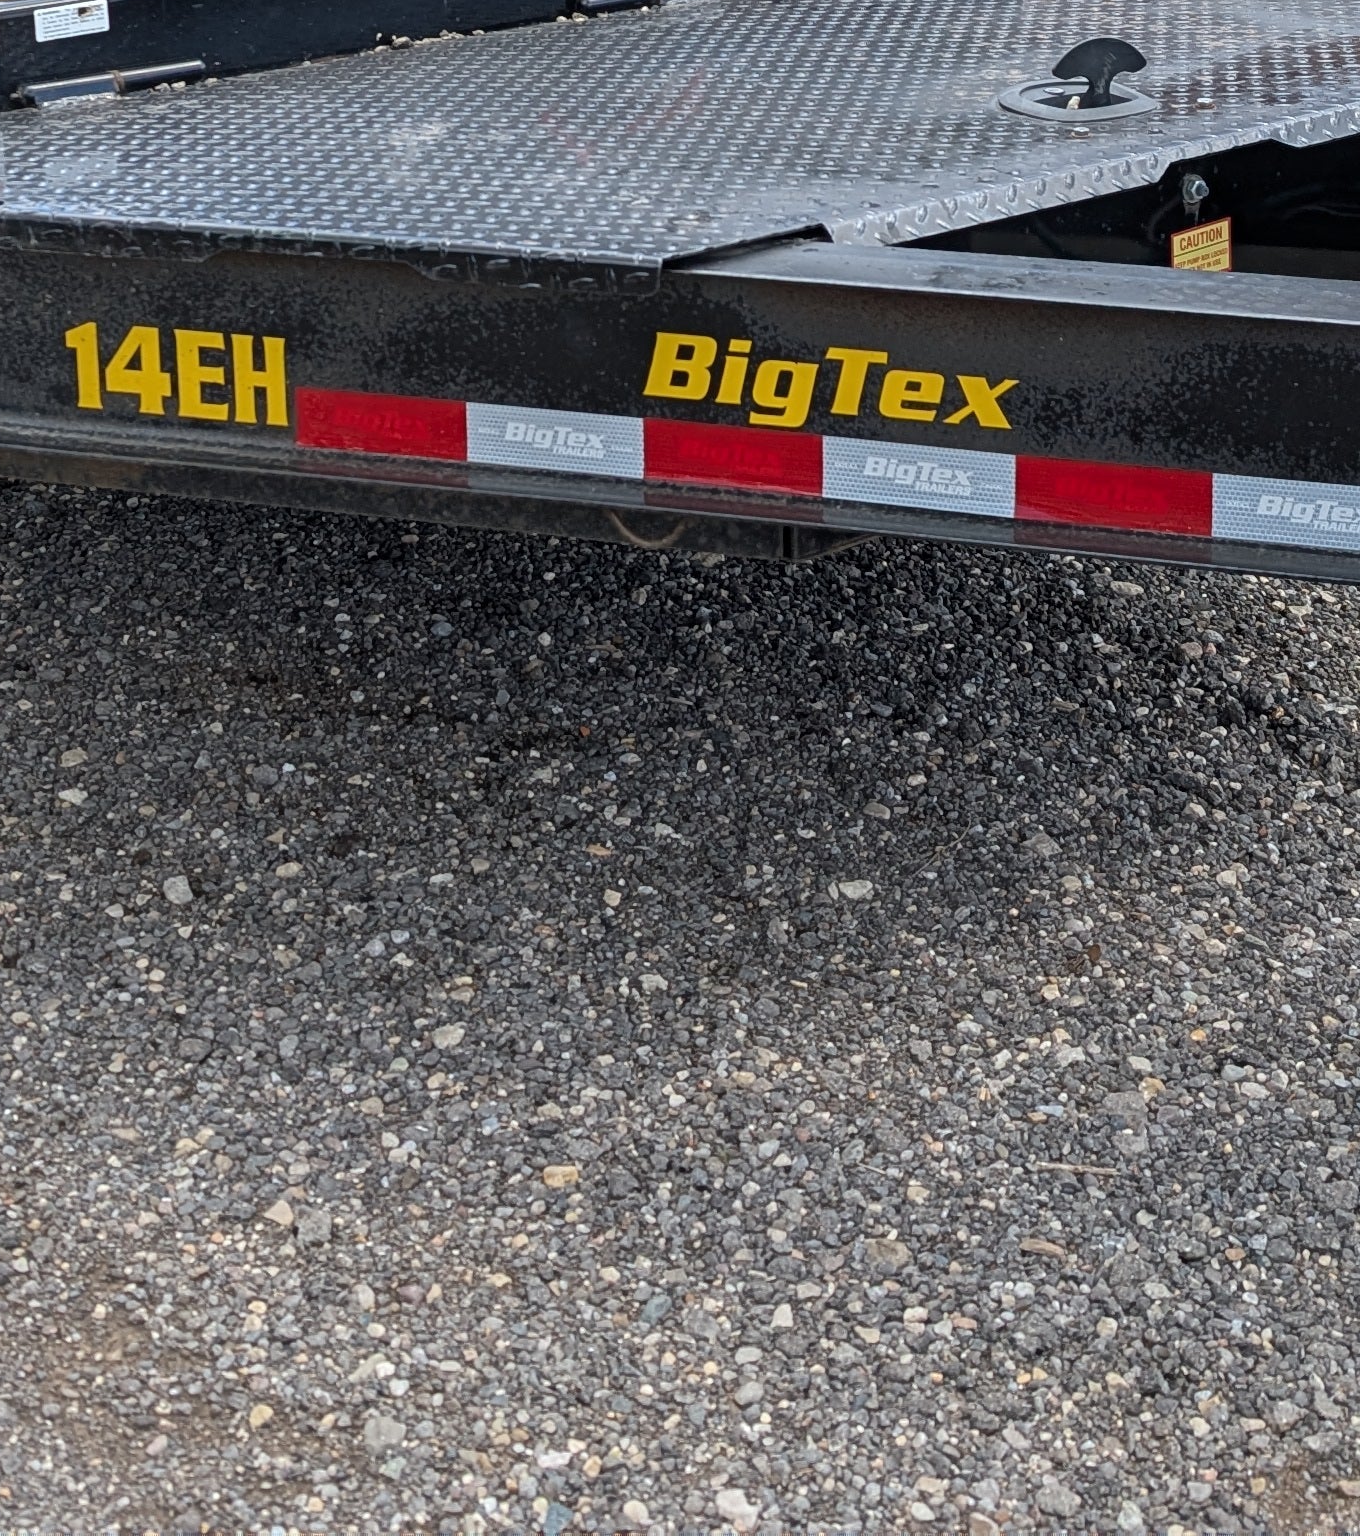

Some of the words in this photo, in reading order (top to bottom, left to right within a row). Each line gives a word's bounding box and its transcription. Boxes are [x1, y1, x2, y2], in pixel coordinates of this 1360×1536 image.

[1179, 225, 1223, 251] CAUTION
[64, 321, 289, 427] 14EH
[643, 331, 1017, 430] BigTex
[504, 421, 605, 449] BigTex
[552, 445, 606, 459] TRAILERS
[863, 455, 973, 486] BigTex
[914, 481, 973, 497] TRAILERS
